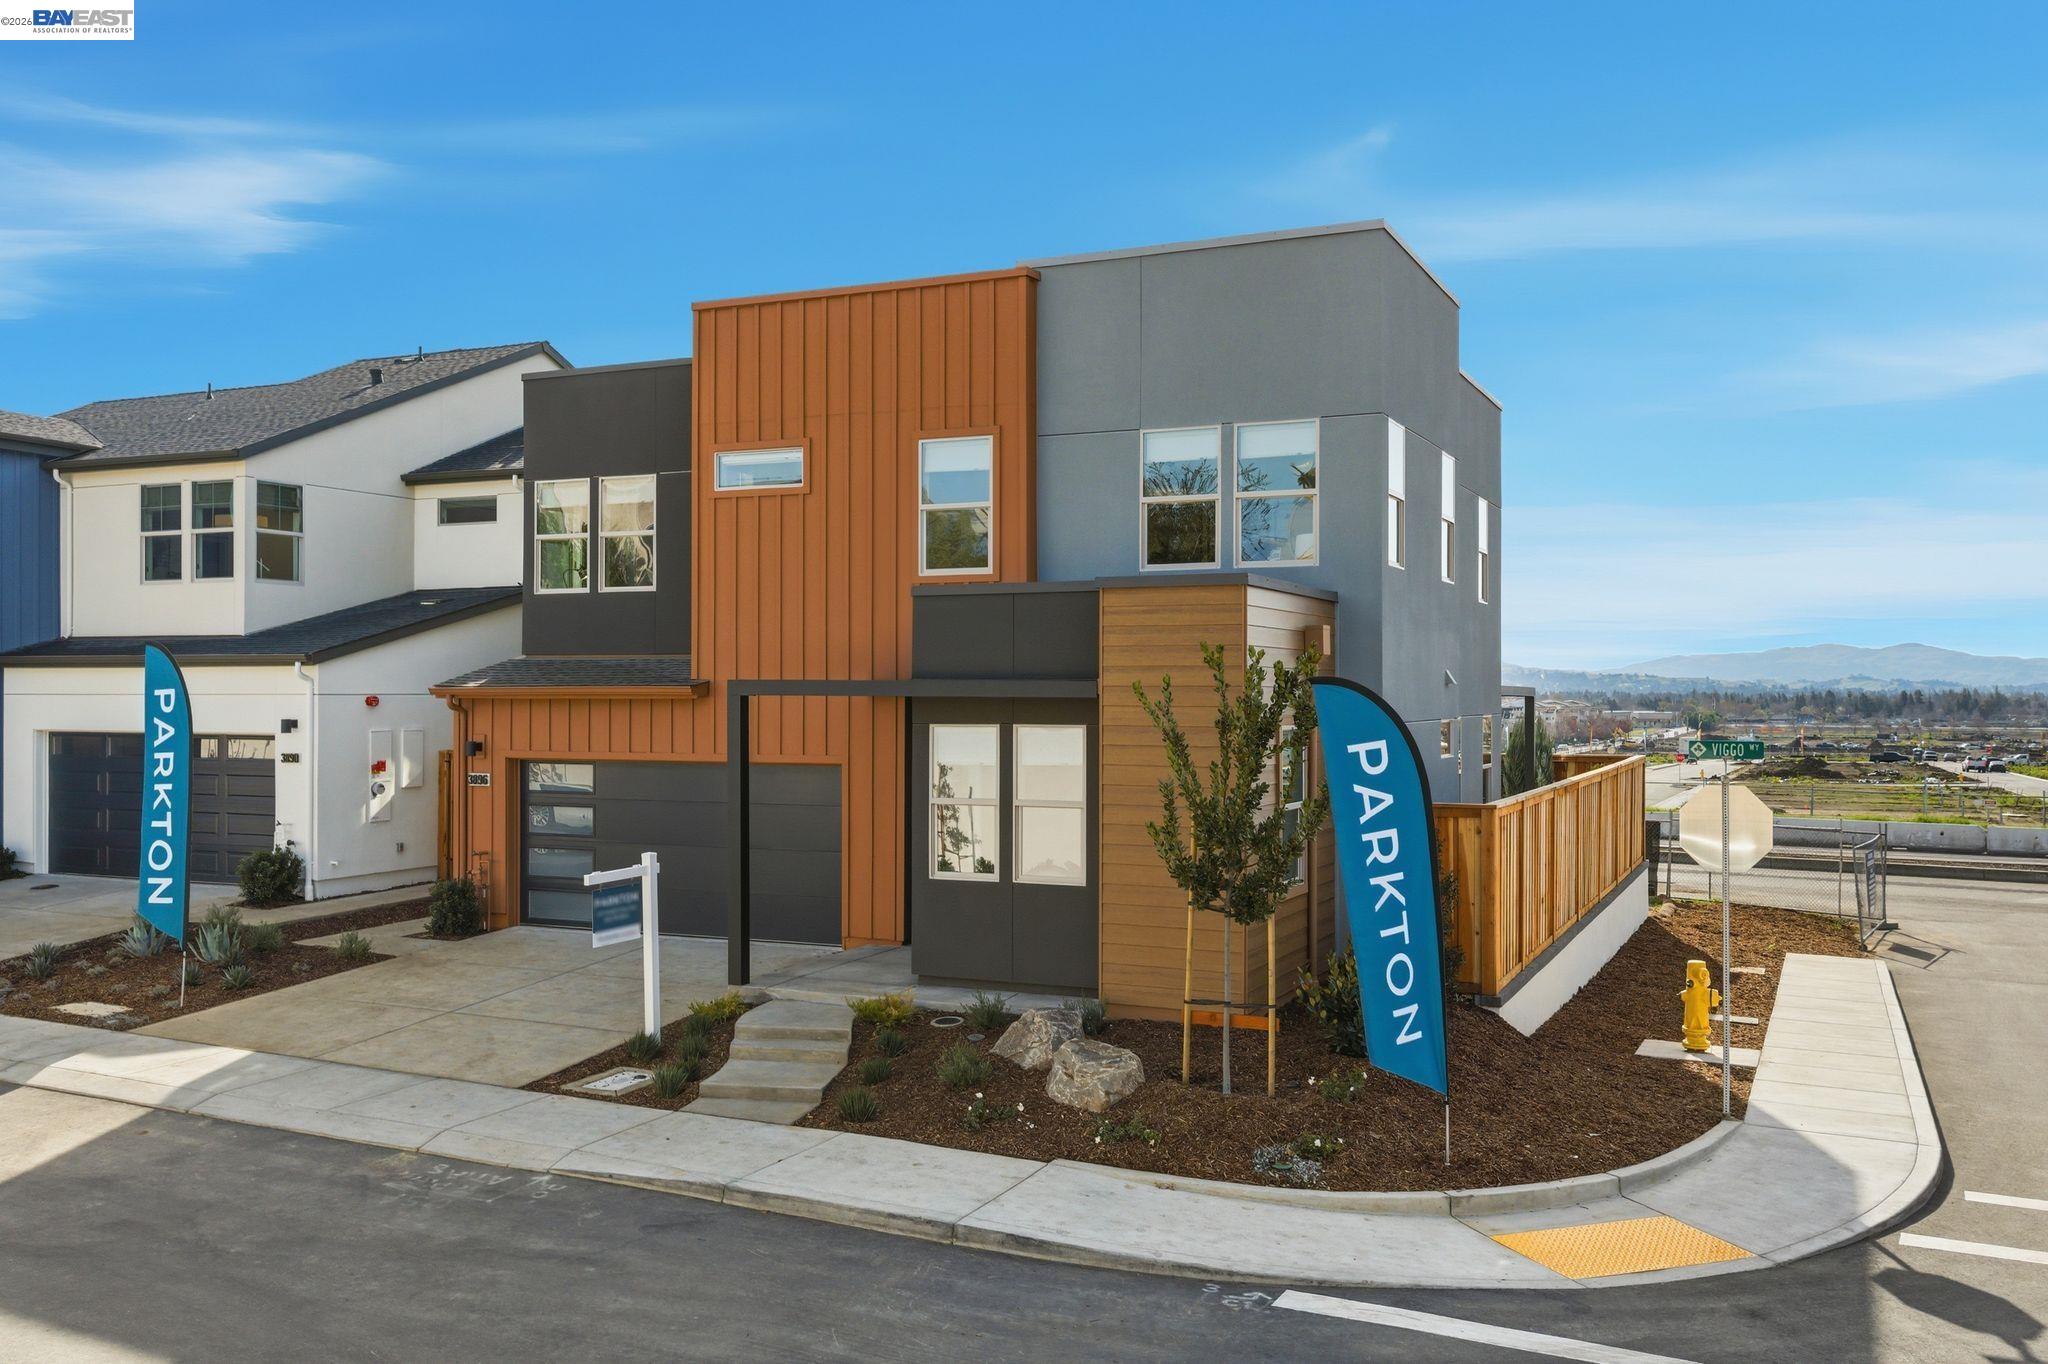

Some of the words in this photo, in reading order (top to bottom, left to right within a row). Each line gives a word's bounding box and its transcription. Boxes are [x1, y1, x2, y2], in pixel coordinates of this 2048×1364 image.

[147, 688, 176, 904] PARKTON
[1711, 743, 1744, 757] VIGGO
[1749, 743, 1760, 751] WY
[1346, 739, 1423, 1046] PARKTON
